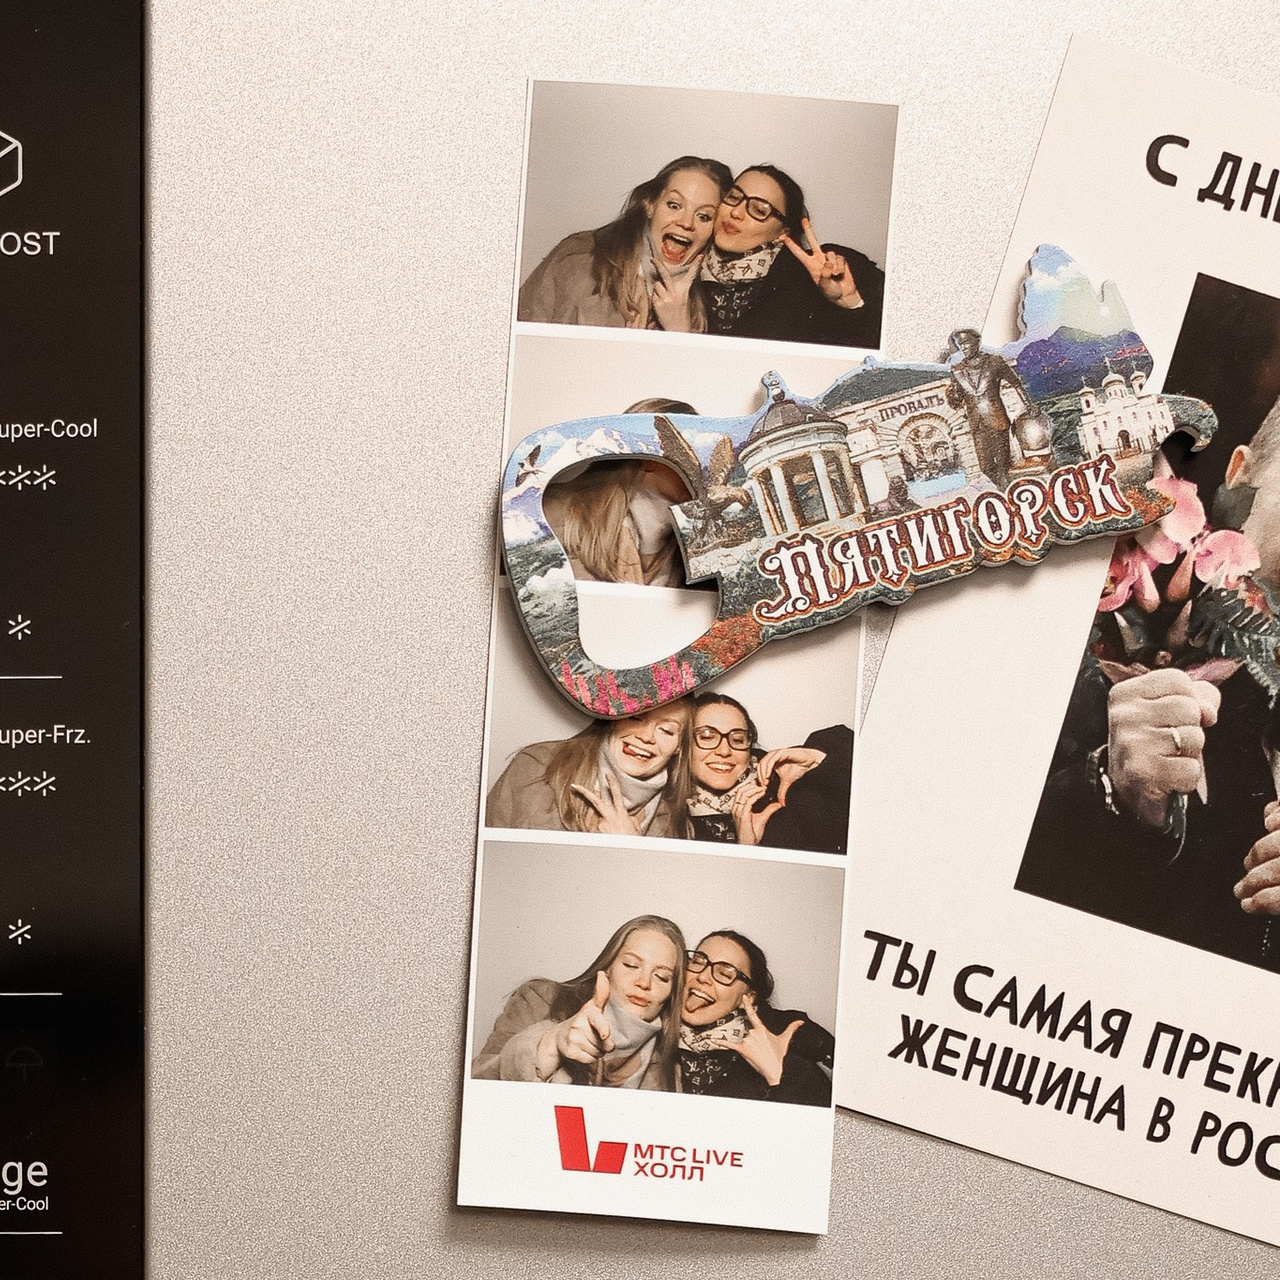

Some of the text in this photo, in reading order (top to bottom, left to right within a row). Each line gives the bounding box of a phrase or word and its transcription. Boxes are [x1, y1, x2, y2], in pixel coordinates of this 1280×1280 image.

[1146, 134, 1280, 225] С ДН
[878, 393, 946, 423] ПРОВАЛЪ
[754, 457, 1130, 622] ПЯТИГОРСК
[864, 929, 937, 997] ТЫ
[953, 963, 1133, 1059] САМАЯ
[887, 1013, 1126, 1132] ЖЕНЩИНА
[1146, 1096, 1175, 1143] В
[633, 1143, 744, 1168] МТС LIVE
[633, 1161, 704, 1182] ХОЛЛ
